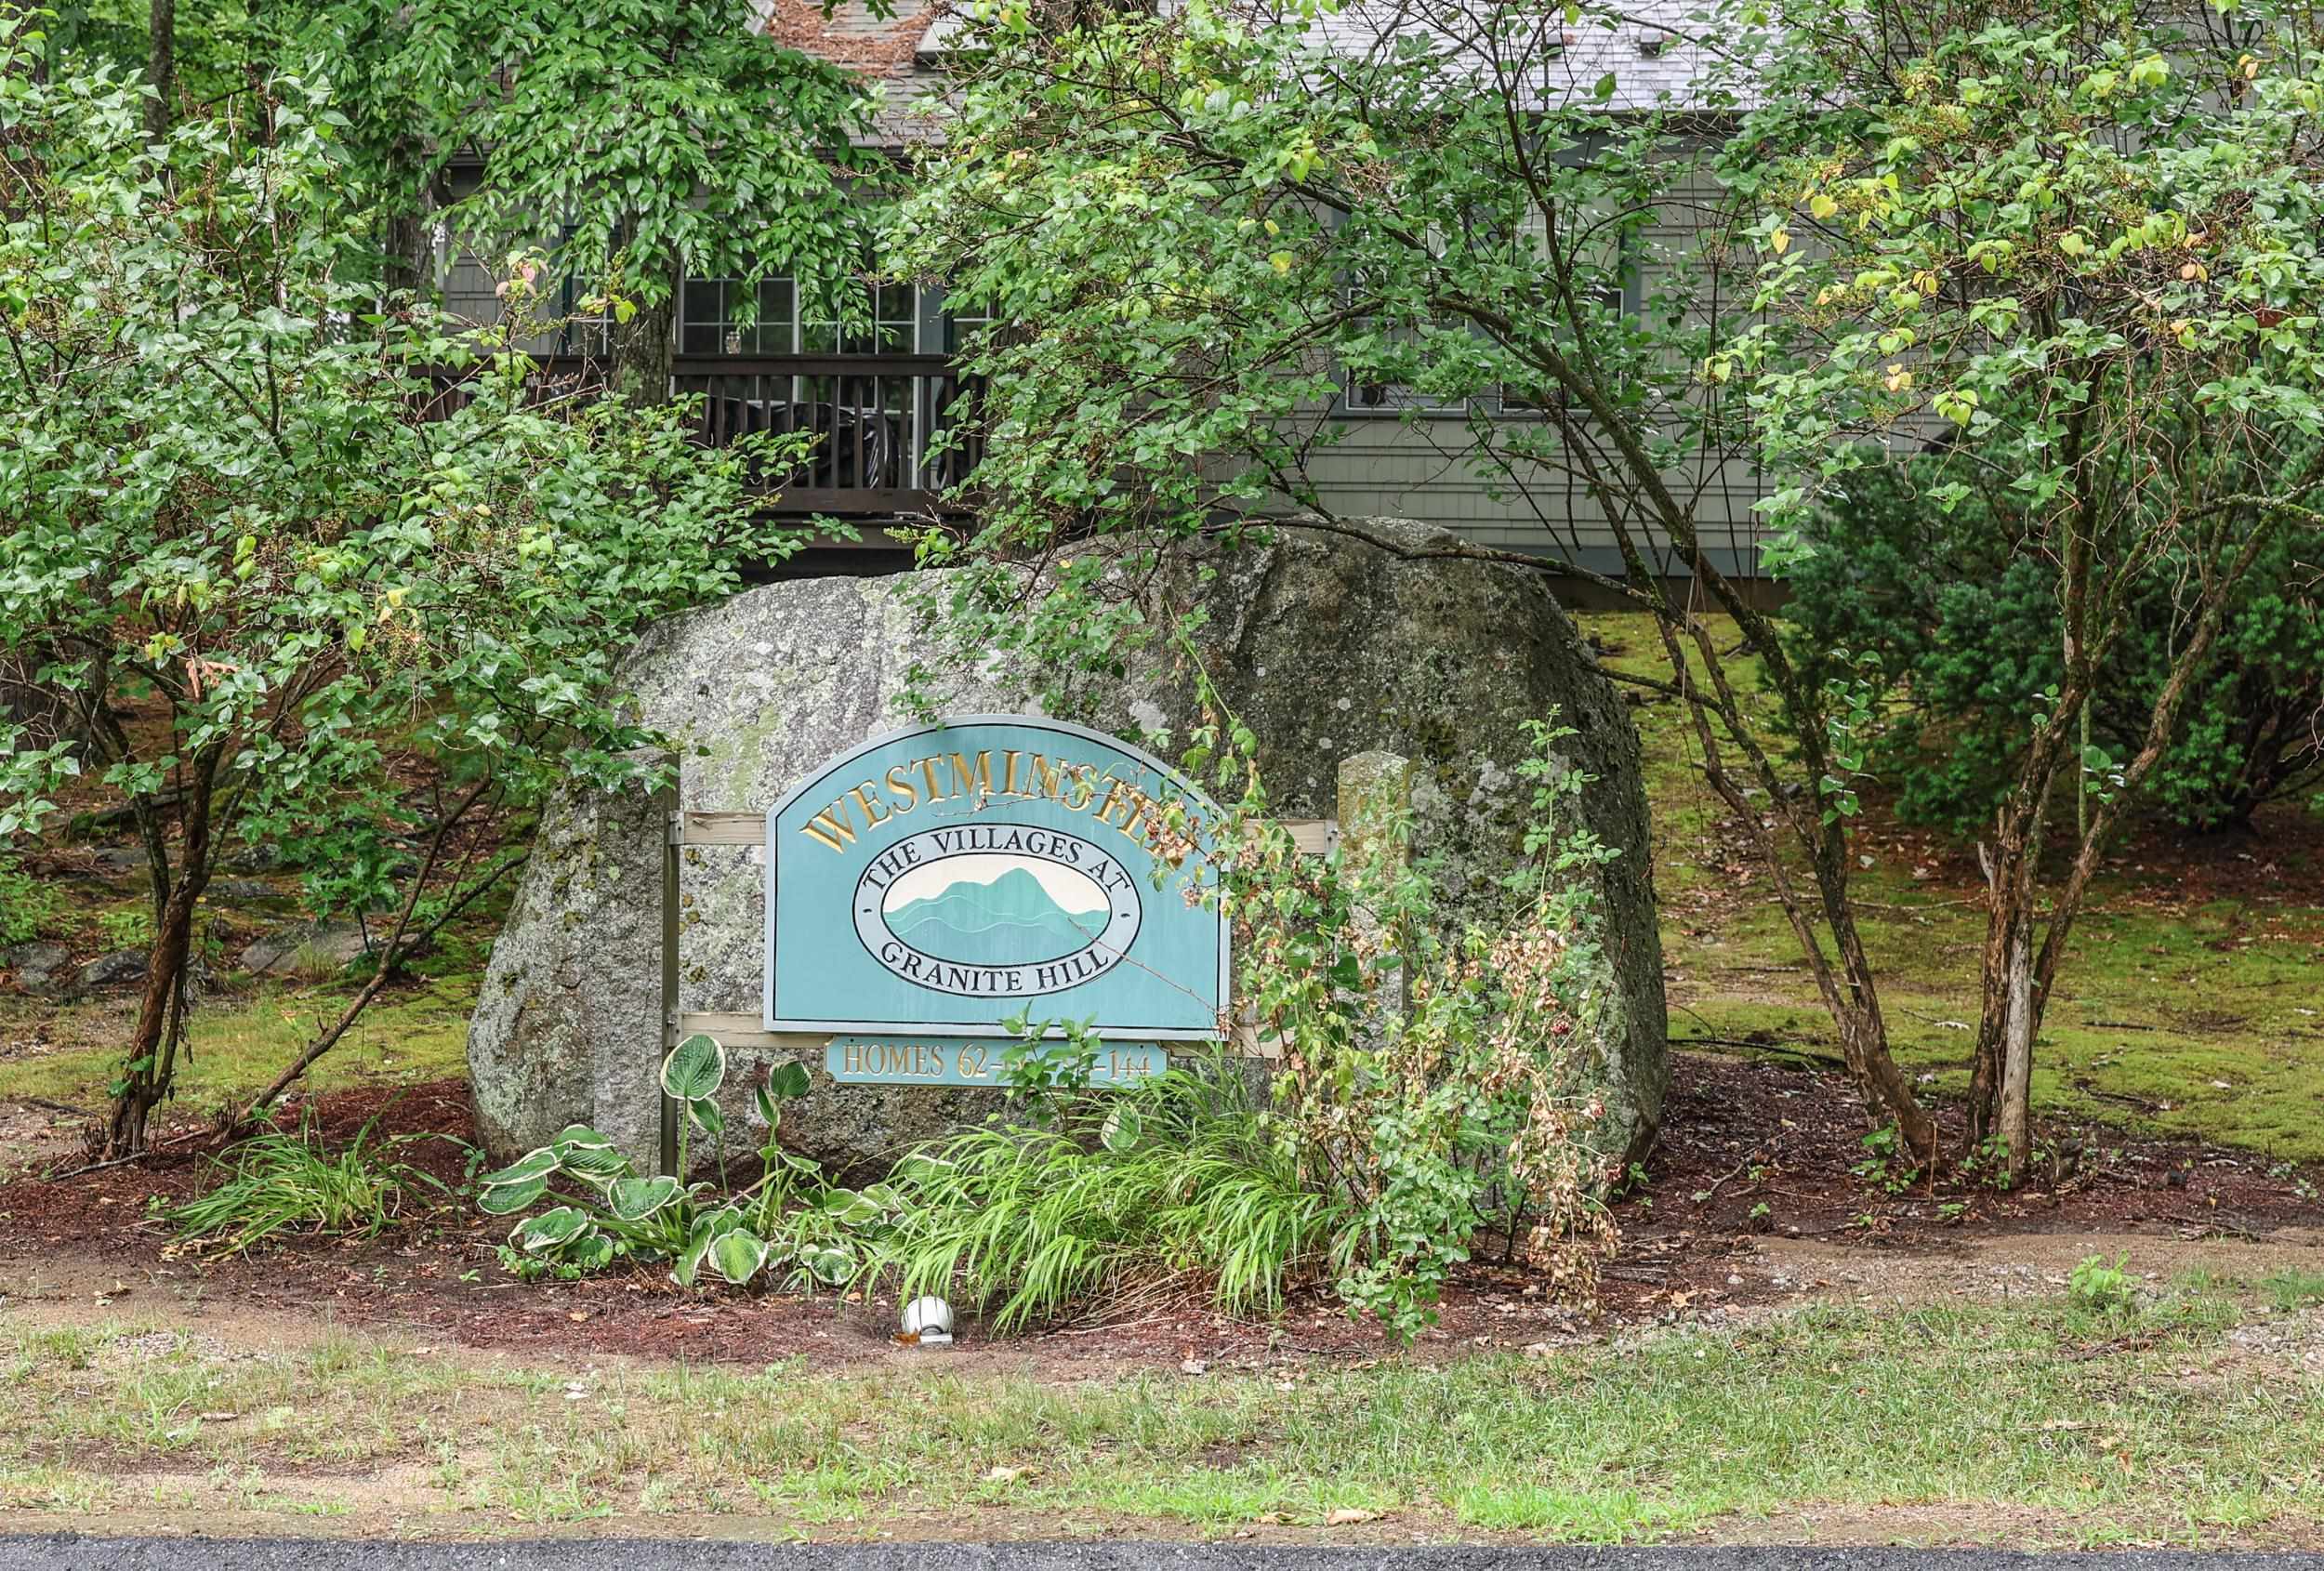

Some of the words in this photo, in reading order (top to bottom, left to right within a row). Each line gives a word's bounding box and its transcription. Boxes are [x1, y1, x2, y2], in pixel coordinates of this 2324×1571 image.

[863, 841, 921, 891] THE
[931, 827, 1083, 864] VILLAGES
[1088, 860, 1130, 892] AT
[881, 942, 1023, 992] GRANITE
[1036, 948, 1109, 989] HILL
[842, 1043, 944, 1078] HOMES
